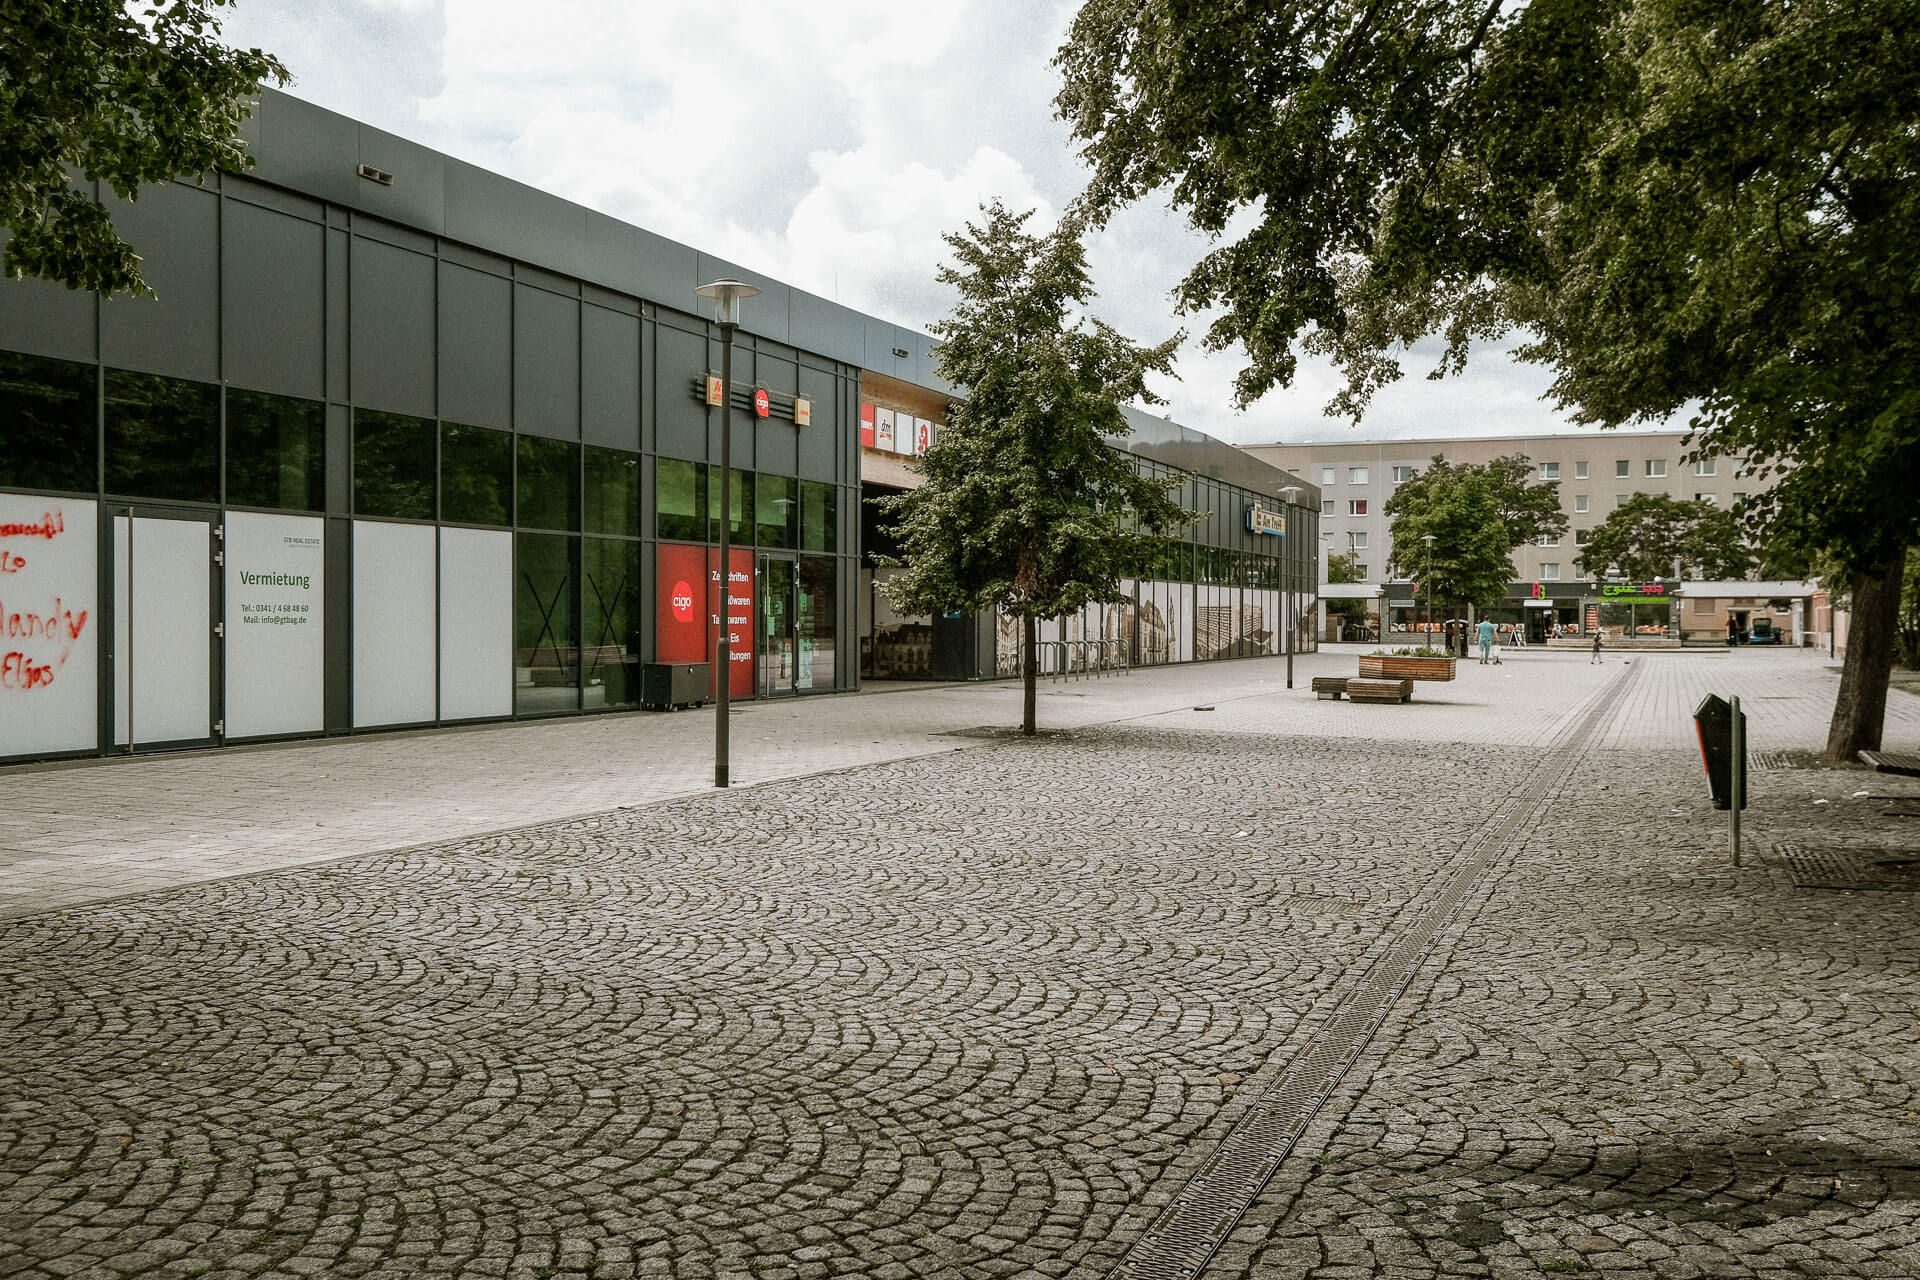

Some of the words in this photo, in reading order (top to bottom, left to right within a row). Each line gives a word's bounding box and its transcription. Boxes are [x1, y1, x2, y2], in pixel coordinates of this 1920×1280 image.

[881, 418, 892, 433] dm
[240, 570, 310, 590] Vermietung
[241, 604, 255, 612] Tel.:
[255, 604, 272, 612] 0341
[292, 604, 300, 612] 48
[300, 604, 309, 612] 60
[673, 593, 692, 611] cigo
[243, 615, 260, 624] Mail:
[261, 615, 307, 625] info@gtbag.de
[730, 632, 740, 643] Eis
